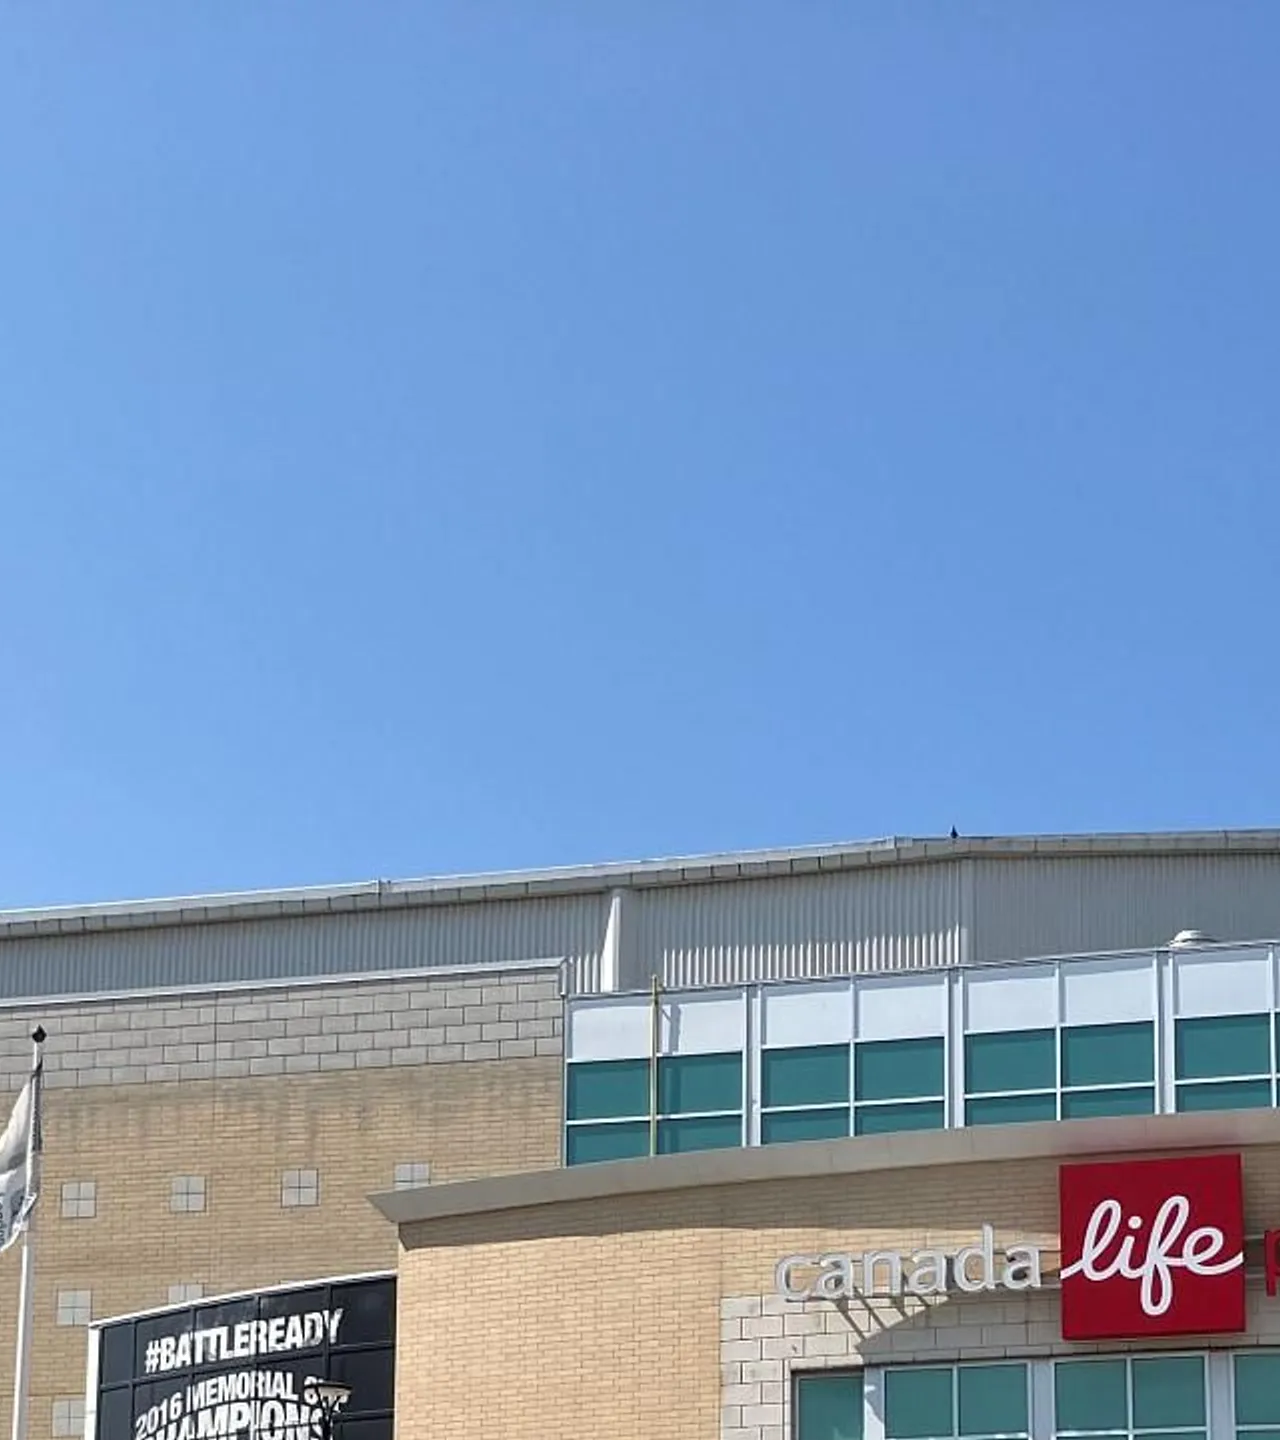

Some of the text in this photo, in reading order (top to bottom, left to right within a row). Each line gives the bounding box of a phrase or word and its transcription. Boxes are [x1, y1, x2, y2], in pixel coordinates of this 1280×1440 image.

[774, 1224, 1042, 1303] canada
[1060, 1195, 1245, 1316] life
[144, 1308, 344, 1374] #BATTLEREADY
[135, 1391, 183, 1440] 2016
[186, 1370, 300, 1414] MEMORIAL
